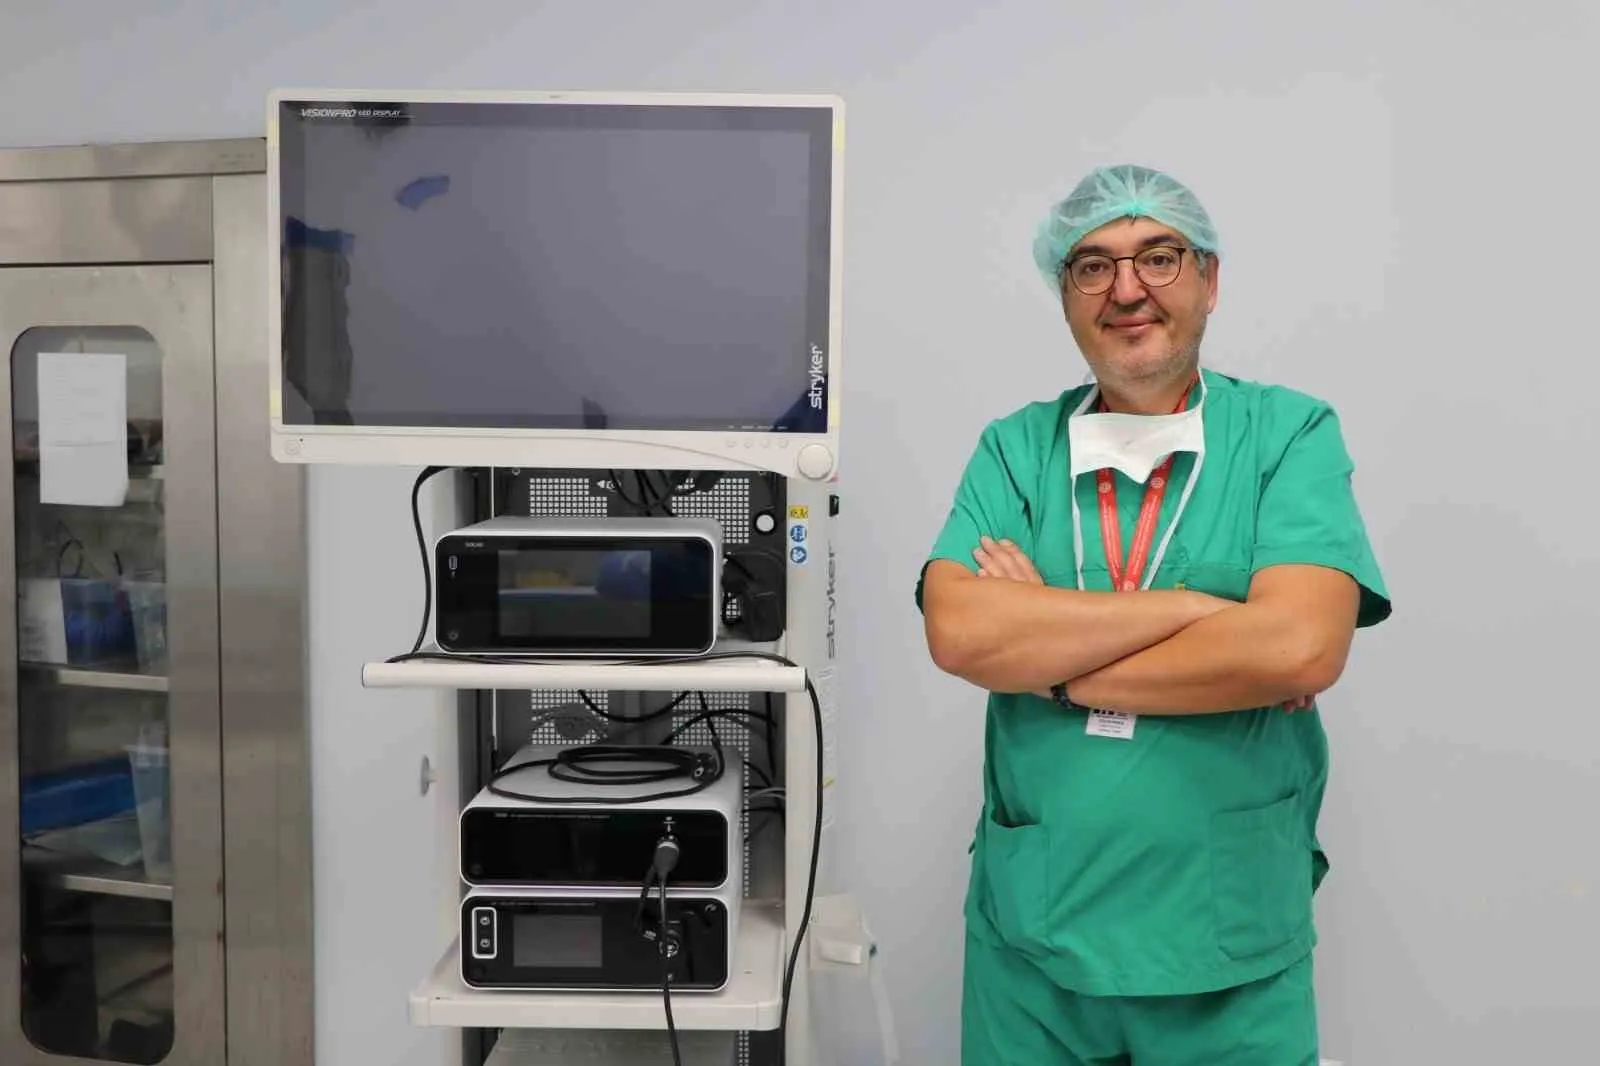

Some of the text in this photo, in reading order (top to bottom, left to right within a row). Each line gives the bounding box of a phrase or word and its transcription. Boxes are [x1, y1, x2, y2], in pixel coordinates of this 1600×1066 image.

[301, 108, 357, 118] VISIONPRO
[372, 110, 401, 118] DISPLAY
[808, 345, 825, 410] stryker
[826, 539, 836, 659] stryker
